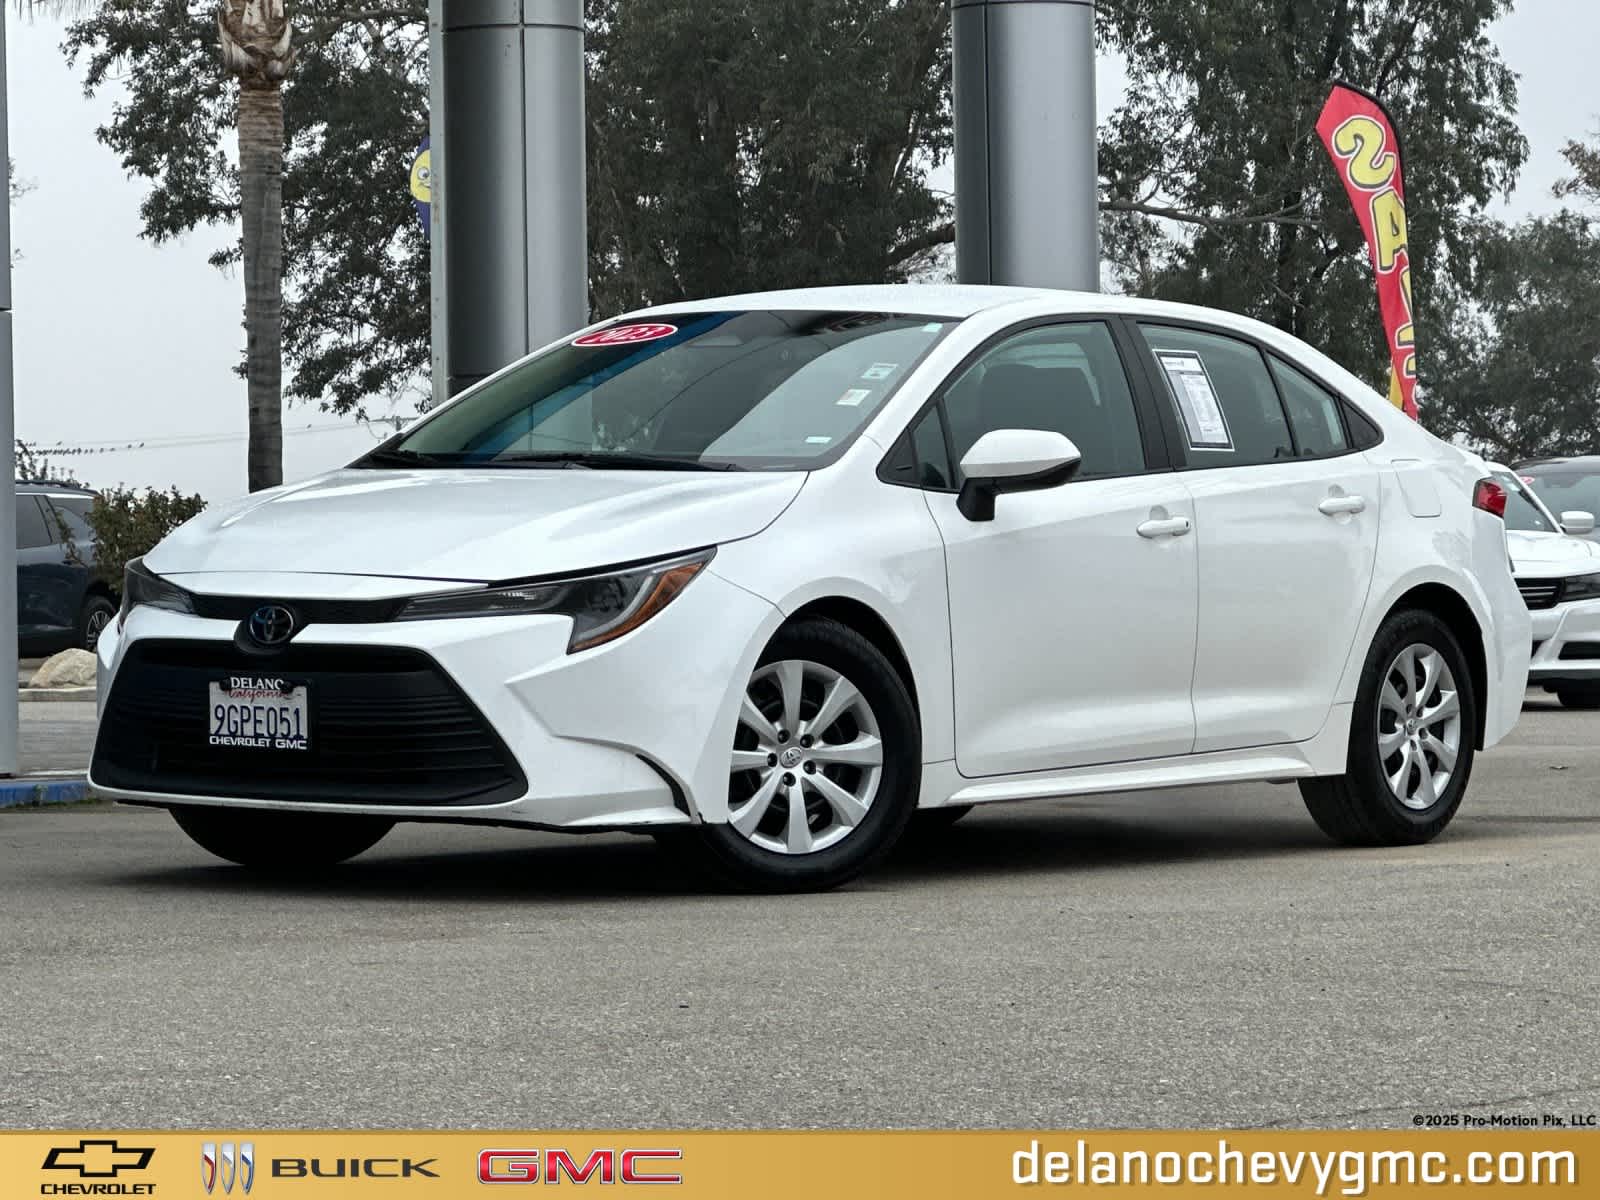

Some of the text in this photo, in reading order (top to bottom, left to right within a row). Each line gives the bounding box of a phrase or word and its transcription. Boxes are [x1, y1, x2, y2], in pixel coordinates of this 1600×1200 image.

[214, 704, 301, 738] 9GPE051
[209, 736, 308, 750] CHEVROLET GMC
